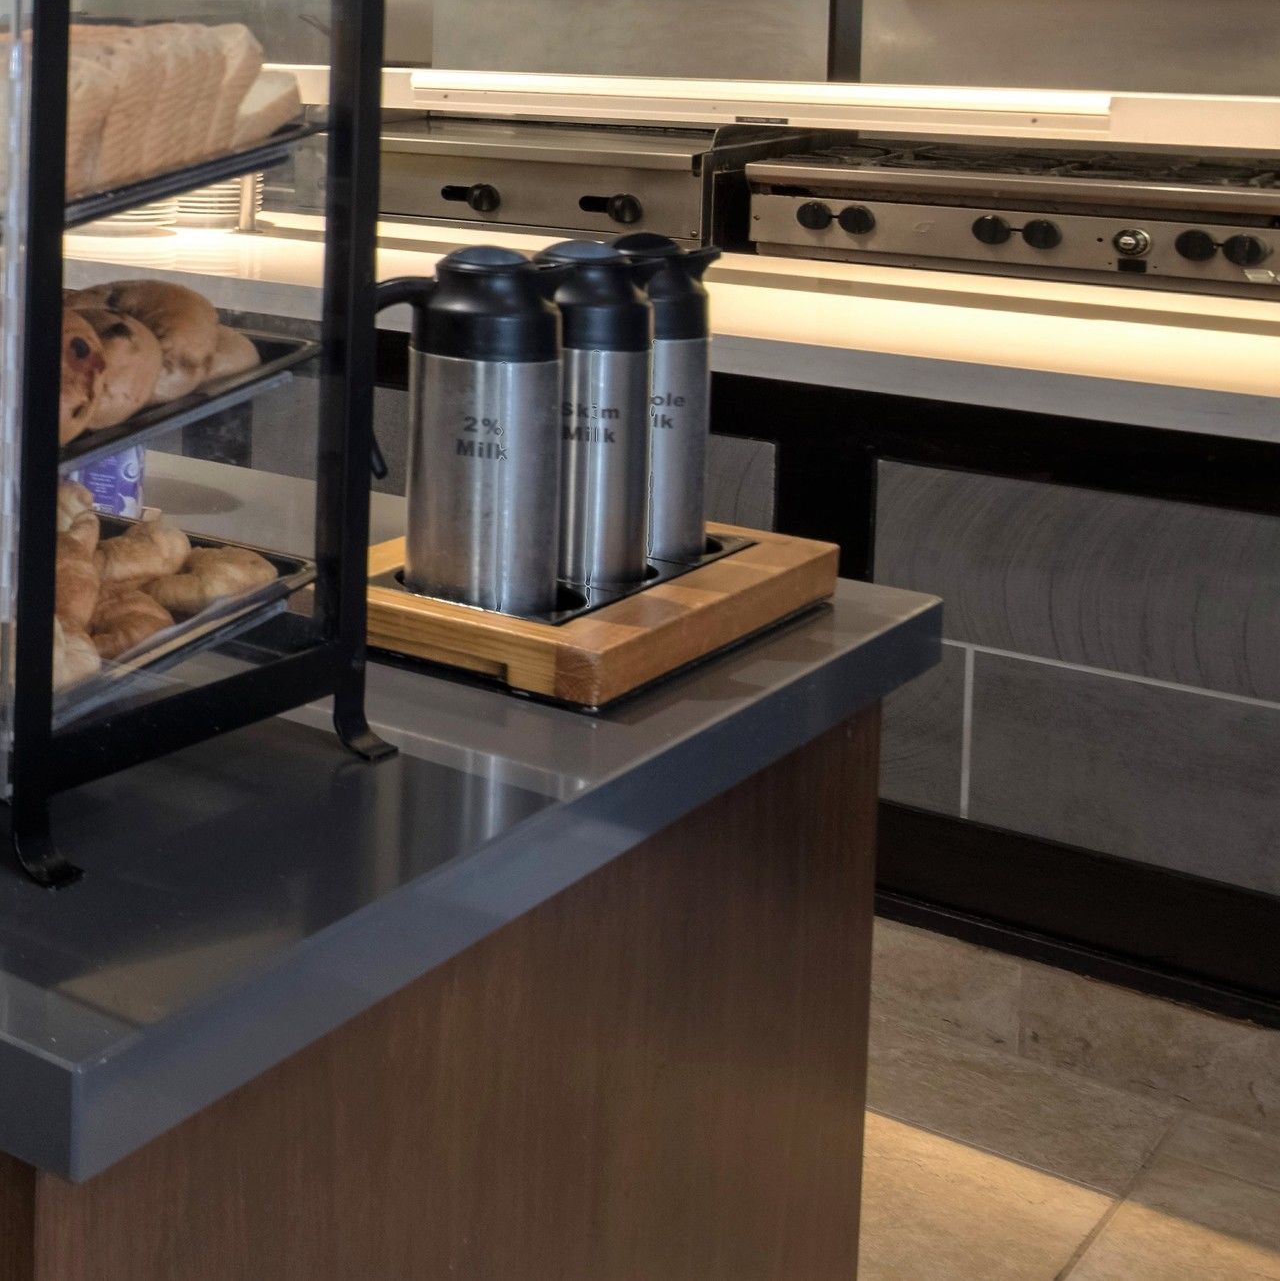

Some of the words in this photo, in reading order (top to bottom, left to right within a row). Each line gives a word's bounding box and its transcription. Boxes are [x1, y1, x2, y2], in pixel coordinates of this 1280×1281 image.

[651, 392, 686, 407] ole
[560, 402, 620, 419] Skim
[463, 417, 504, 436] 2%
[653, 413, 673, 429] lk
[560, 426, 616, 443] Milk
[456, 438, 507, 460] Milk
